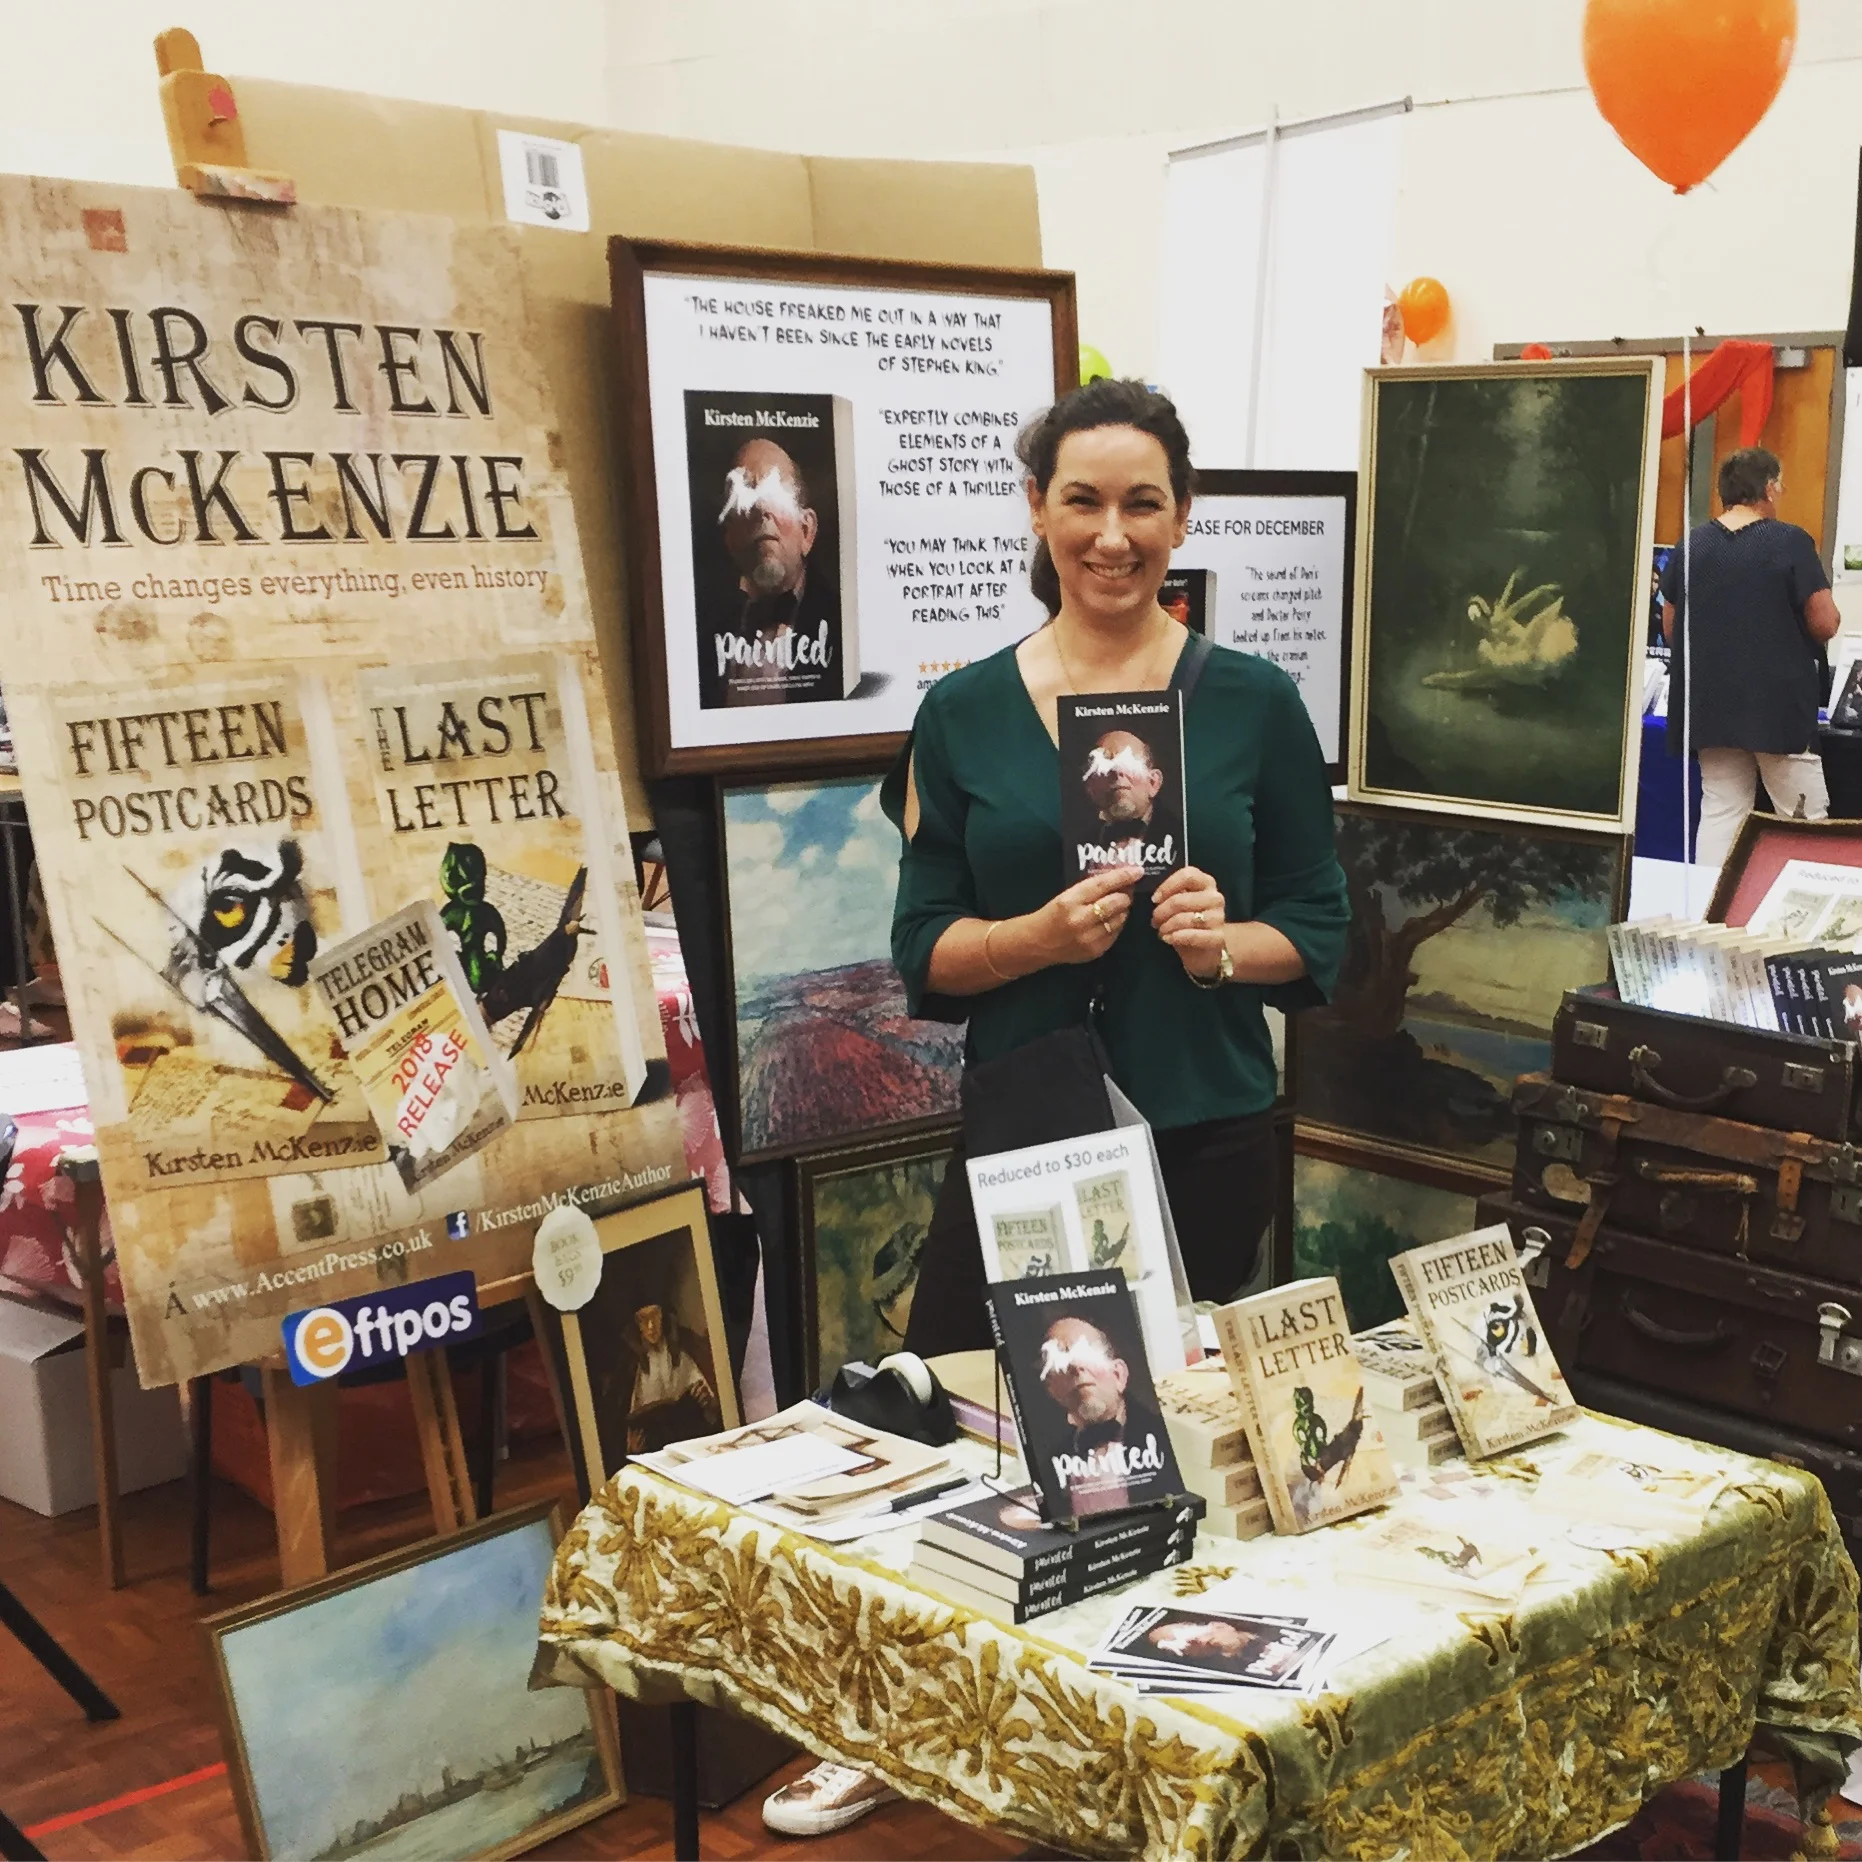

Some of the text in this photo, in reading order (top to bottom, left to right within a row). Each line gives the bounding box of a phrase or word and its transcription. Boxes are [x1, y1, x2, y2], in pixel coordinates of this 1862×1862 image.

[724, 299, 773, 318] HOUSE
[780, 302, 846, 321] FREAKED
[851, 305, 872, 323] ME
[878, 308, 903, 323] OUT
[910, 311, 921, 324] IN
[928, 312, 937, 325] A
[943, 312, 969, 328] WAY
[975, 313, 1001, 329] THAT
[710, 325, 769, 342] HAVEN'T
[776, 328, 813, 344] BEEN
[820, 329, 858, 347] SINCE
[866, 332, 889, 348] THE
[895, 334, 935, 350] EARLY
[941, 336, 992, 352] NOVELS
[12, 303, 494, 419] KIRSTEN
[878, 357, 896, 372] OF
[901, 357, 960, 374] STEPHEN
[704, 408, 820, 429] Kirsten McKenzie
[954, 410, 1018, 427] COMBINES
[899, 434, 1001, 450] ELEMENTS OF A
[888, 457, 1013, 473] GHOST STORY WITH
[880, 481, 921, 497] THOSE
[926, 481, 943, 497] OF
[948, 482, 957, 496] A
[920, 538, 947, 554] MAY
[953, 537, 986, 553] THINK
[993, 537, 1029, 553] TWICE
[1225, 519, 1252, 536] FOR
[1256, 519, 1325, 536] DECEMBER
[41, 564, 548, 604] Time changes everything, even history
[887, 559, 1027, 578] WHEN YOU LOOK AT A
[903, 582, 1008, 601] PORTRAIT AFTER
[912, 606, 970, 624] READING
[714, 618, 834, 677] painted
[394, 690, 549, 766] LAST
[1074, 702, 1171, 718] Kirsten McKenzie
[66, 700, 290, 777] FIFTEEN
[370, 706, 396, 773] THE
[73, 774, 314, 841] POSTCARDS
[386, 768, 570, 834] LETTER
[1076, 834, 1178, 871] painted
[315, 920, 429, 1001] TELEGRAM
[332, 949, 445, 1039] HOME
[391, 1032, 434, 1095] 2018
[397, 1028, 469, 1139] RELEASE
[523, 1078, 626, 1107] McKenzie
[143, 1133, 377, 1178] Kirsten McKenzie
[977, 1143, 1130, 1189] Reduced to $30 each
[1082, 1179, 1122, 1203] LAST
[193, 1230, 433, 1311] www.AccentPress.co.uk
[1421, 1239, 1509, 1285] FIFTEEN
[1014, 1281, 1117, 1306] Kirsten McKenzie
[1427, 1267, 1522, 1310] POSTCARDS
[303, 1294, 474, 1370] eftpos
[1259, 1294, 1337, 1345] LAST
[1257, 1332, 1351, 1379] LETTER
[1050, 1433, 1165, 1490] painted
